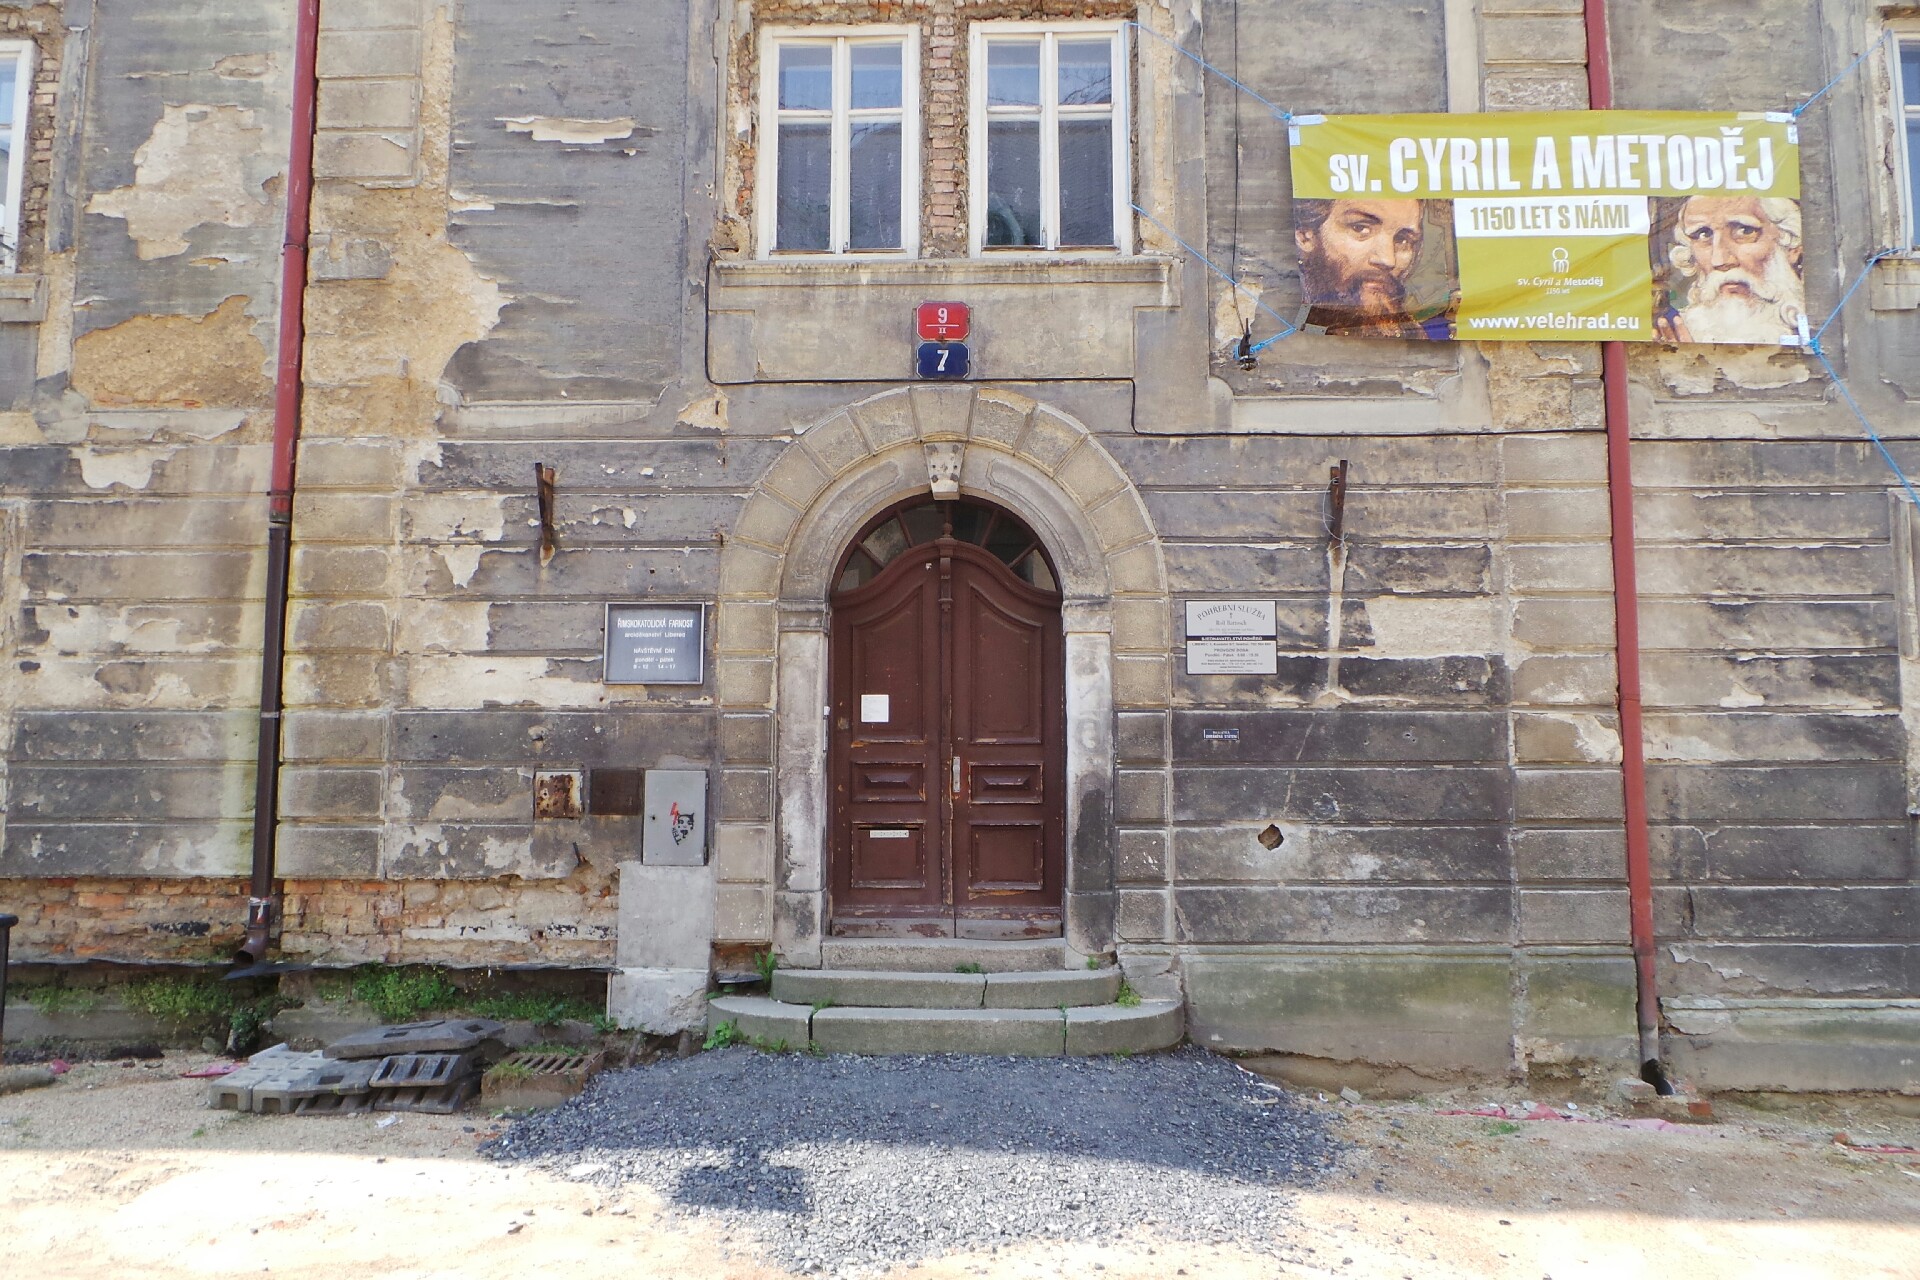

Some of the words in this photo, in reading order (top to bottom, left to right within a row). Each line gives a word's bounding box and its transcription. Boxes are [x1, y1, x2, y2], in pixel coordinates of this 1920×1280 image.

[1329, 153, 1382, 192] SV.
[1389, 137, 1521, 192] CYRIL
[1531, 136, 1562, 190] A
[1571, 126, 1775, 191] METODĚJ
[1470, 206, 1516, 231] 1150
[1520, 205, 1552, 231] LET
[1557, 204, 1571, 230] S
[1575, 200, 1630, 230] NÁMI
[1517, 278, 1530, 287] sv.
[1532, 277, 1554, 289] Cyril
[1555, 279, 1562, 287] a
[1564, 276, 1604, 288] Metoděj
[1545, 287, 1561, 296] 1150
[937, 307, 948, 324] 9
[1469, 312, 1640, 330] www.velehrad.eu
[937, 349, 949, 372] 7
[1197, 604, 1237, 621] POHŘEBNÍ
[1237, 605, 1267, 621] SLUŽBA
[668, 619, 694, 629] FARNOST
[664, 647, 676, 655] DNY
